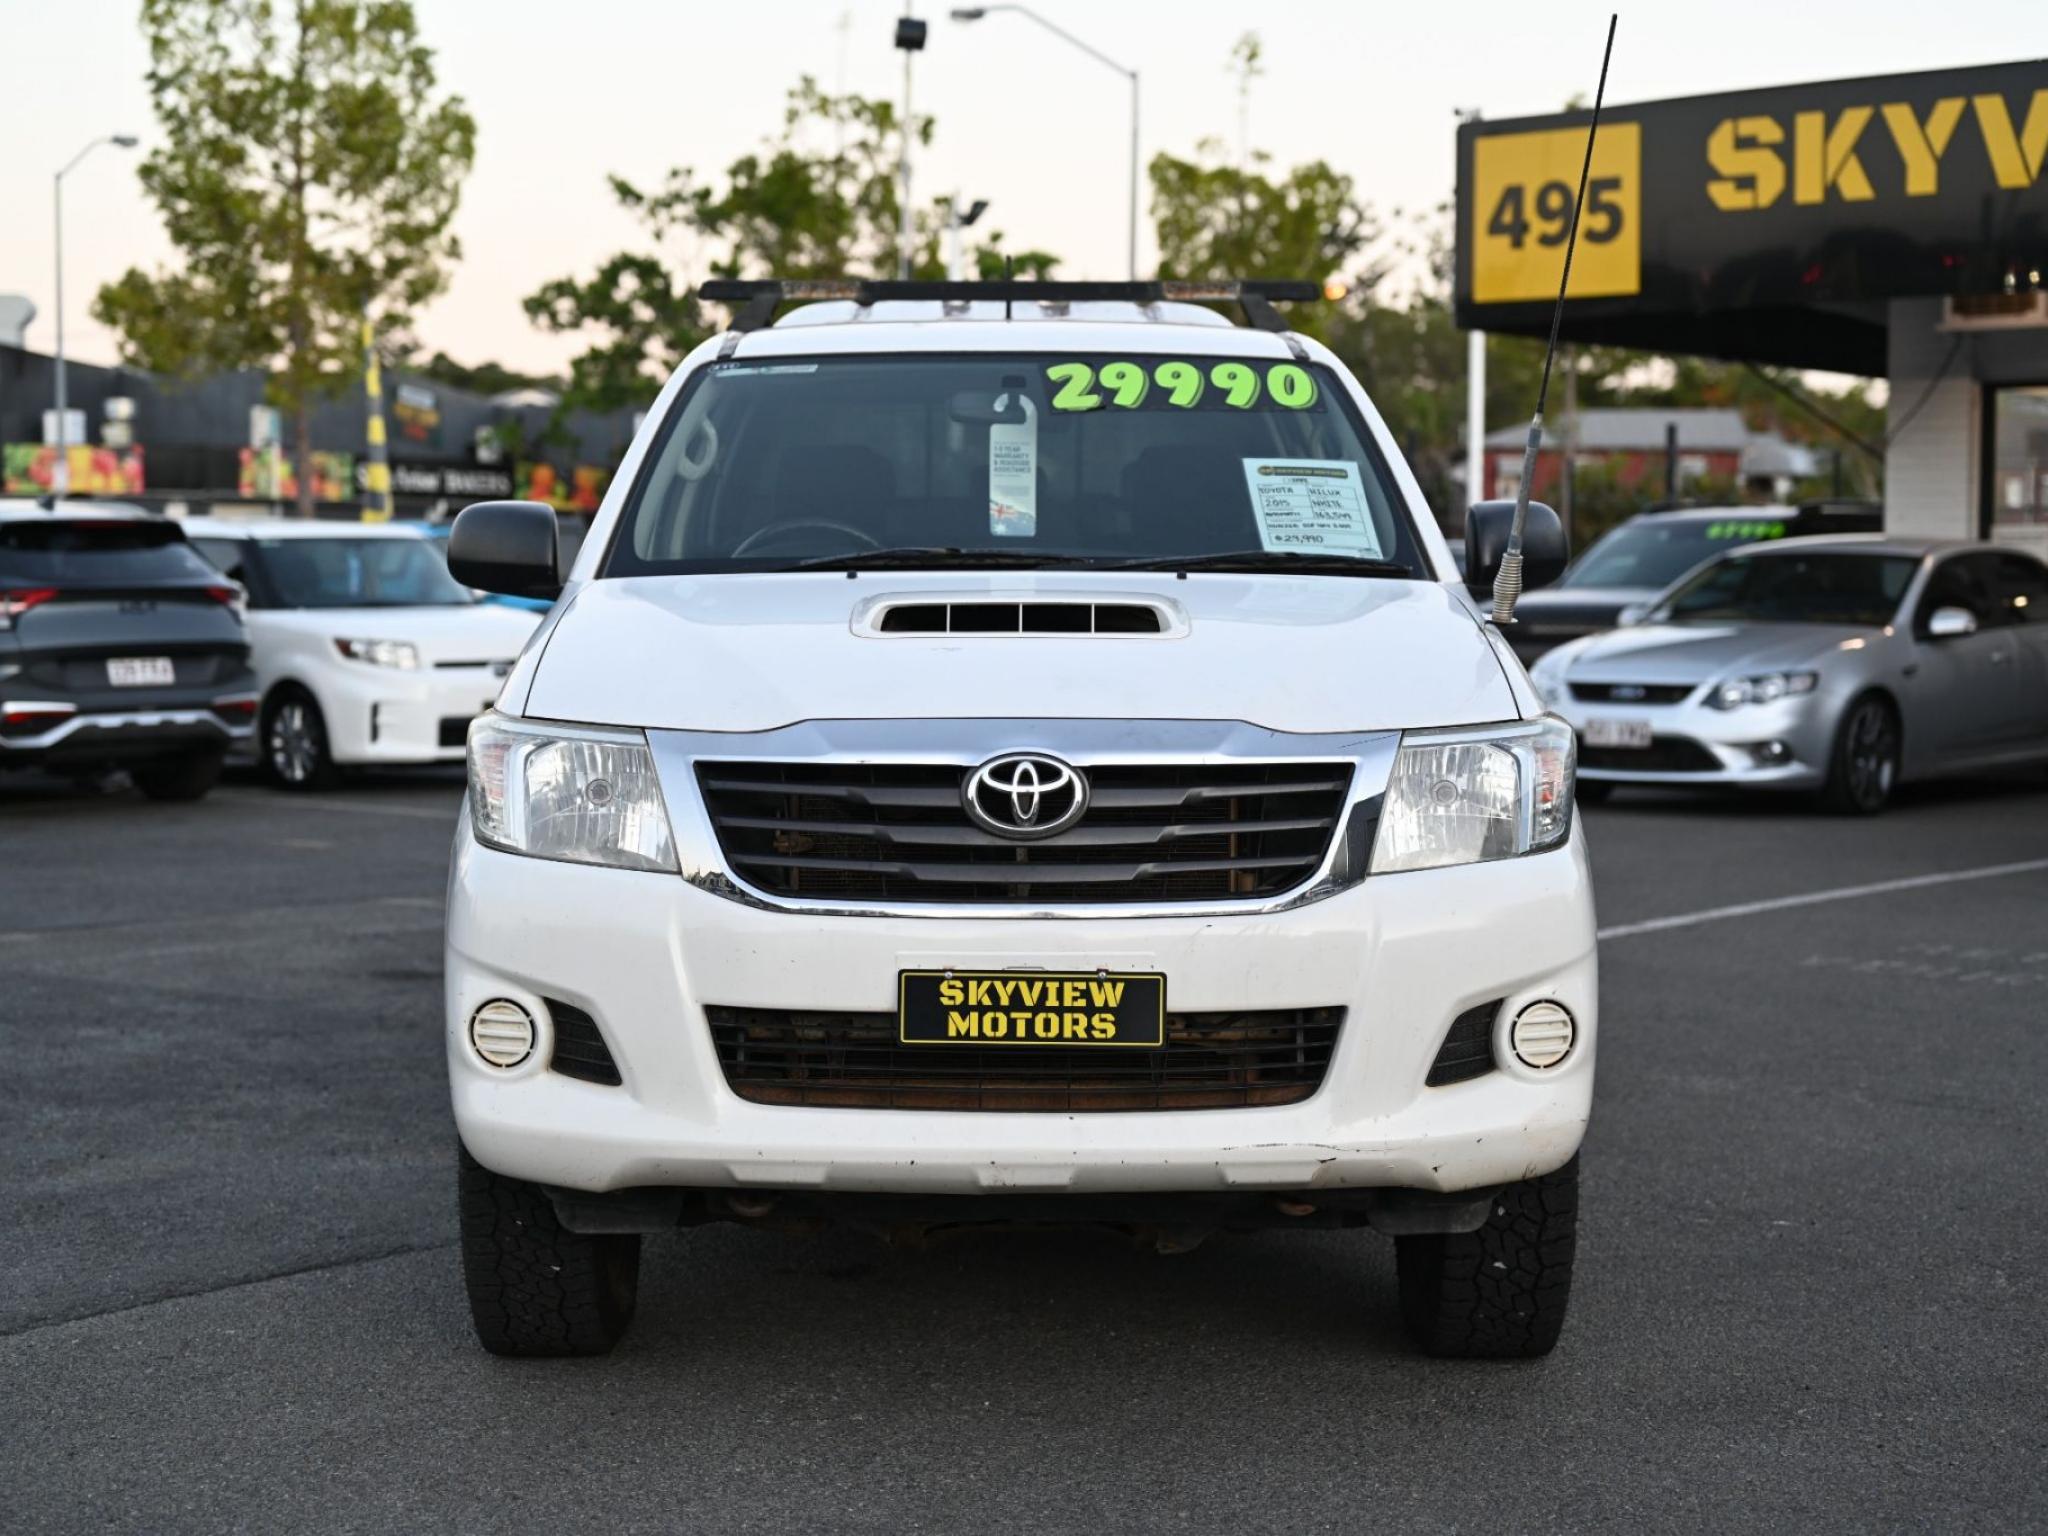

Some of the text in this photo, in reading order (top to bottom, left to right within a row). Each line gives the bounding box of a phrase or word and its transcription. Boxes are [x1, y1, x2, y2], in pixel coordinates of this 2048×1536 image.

[1706, 88, 2048, 212] SKYV
[1487, 177, 1624, 250] 495
[1046, 361, 1318, 410] 29990
[1309, 488, 1341, 497] HILUX
[939, 980, 1125, 1007] SKYVIEW
[947, 1012, 1116, 1039] MOTORS
